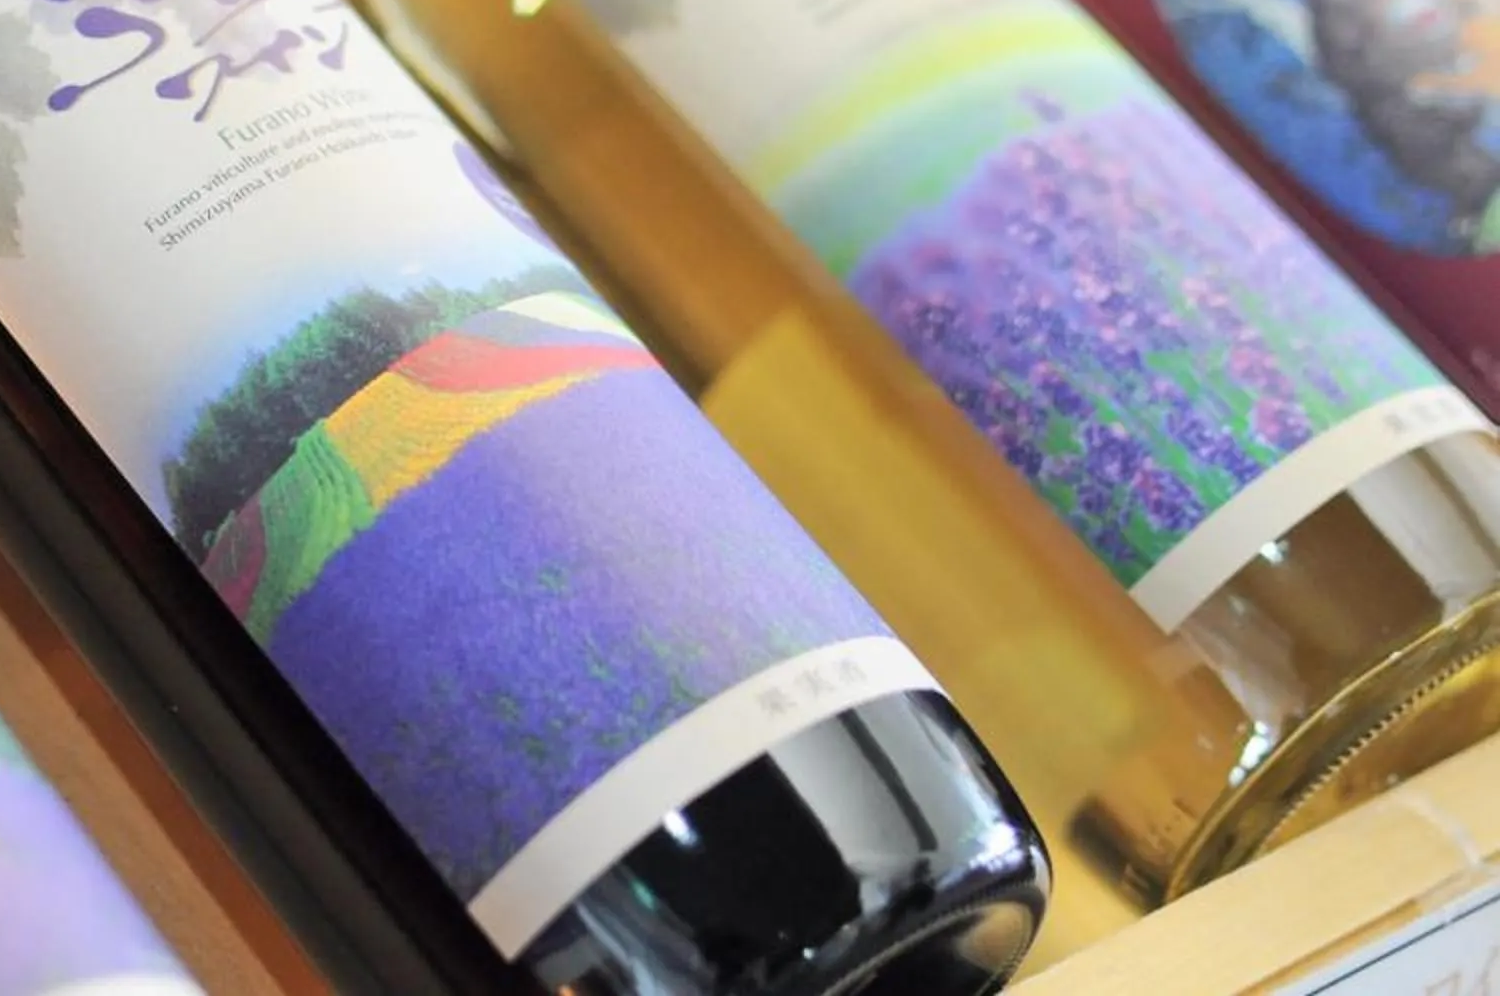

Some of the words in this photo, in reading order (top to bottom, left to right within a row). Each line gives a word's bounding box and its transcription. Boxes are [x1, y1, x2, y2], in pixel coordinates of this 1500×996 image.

[217, 103, 312, 153] Furano
[143, 187, 201, 235] Furano
[202, 143, 280, 194] viticulture
[158, 176, 266, 252] Shimizuyama
